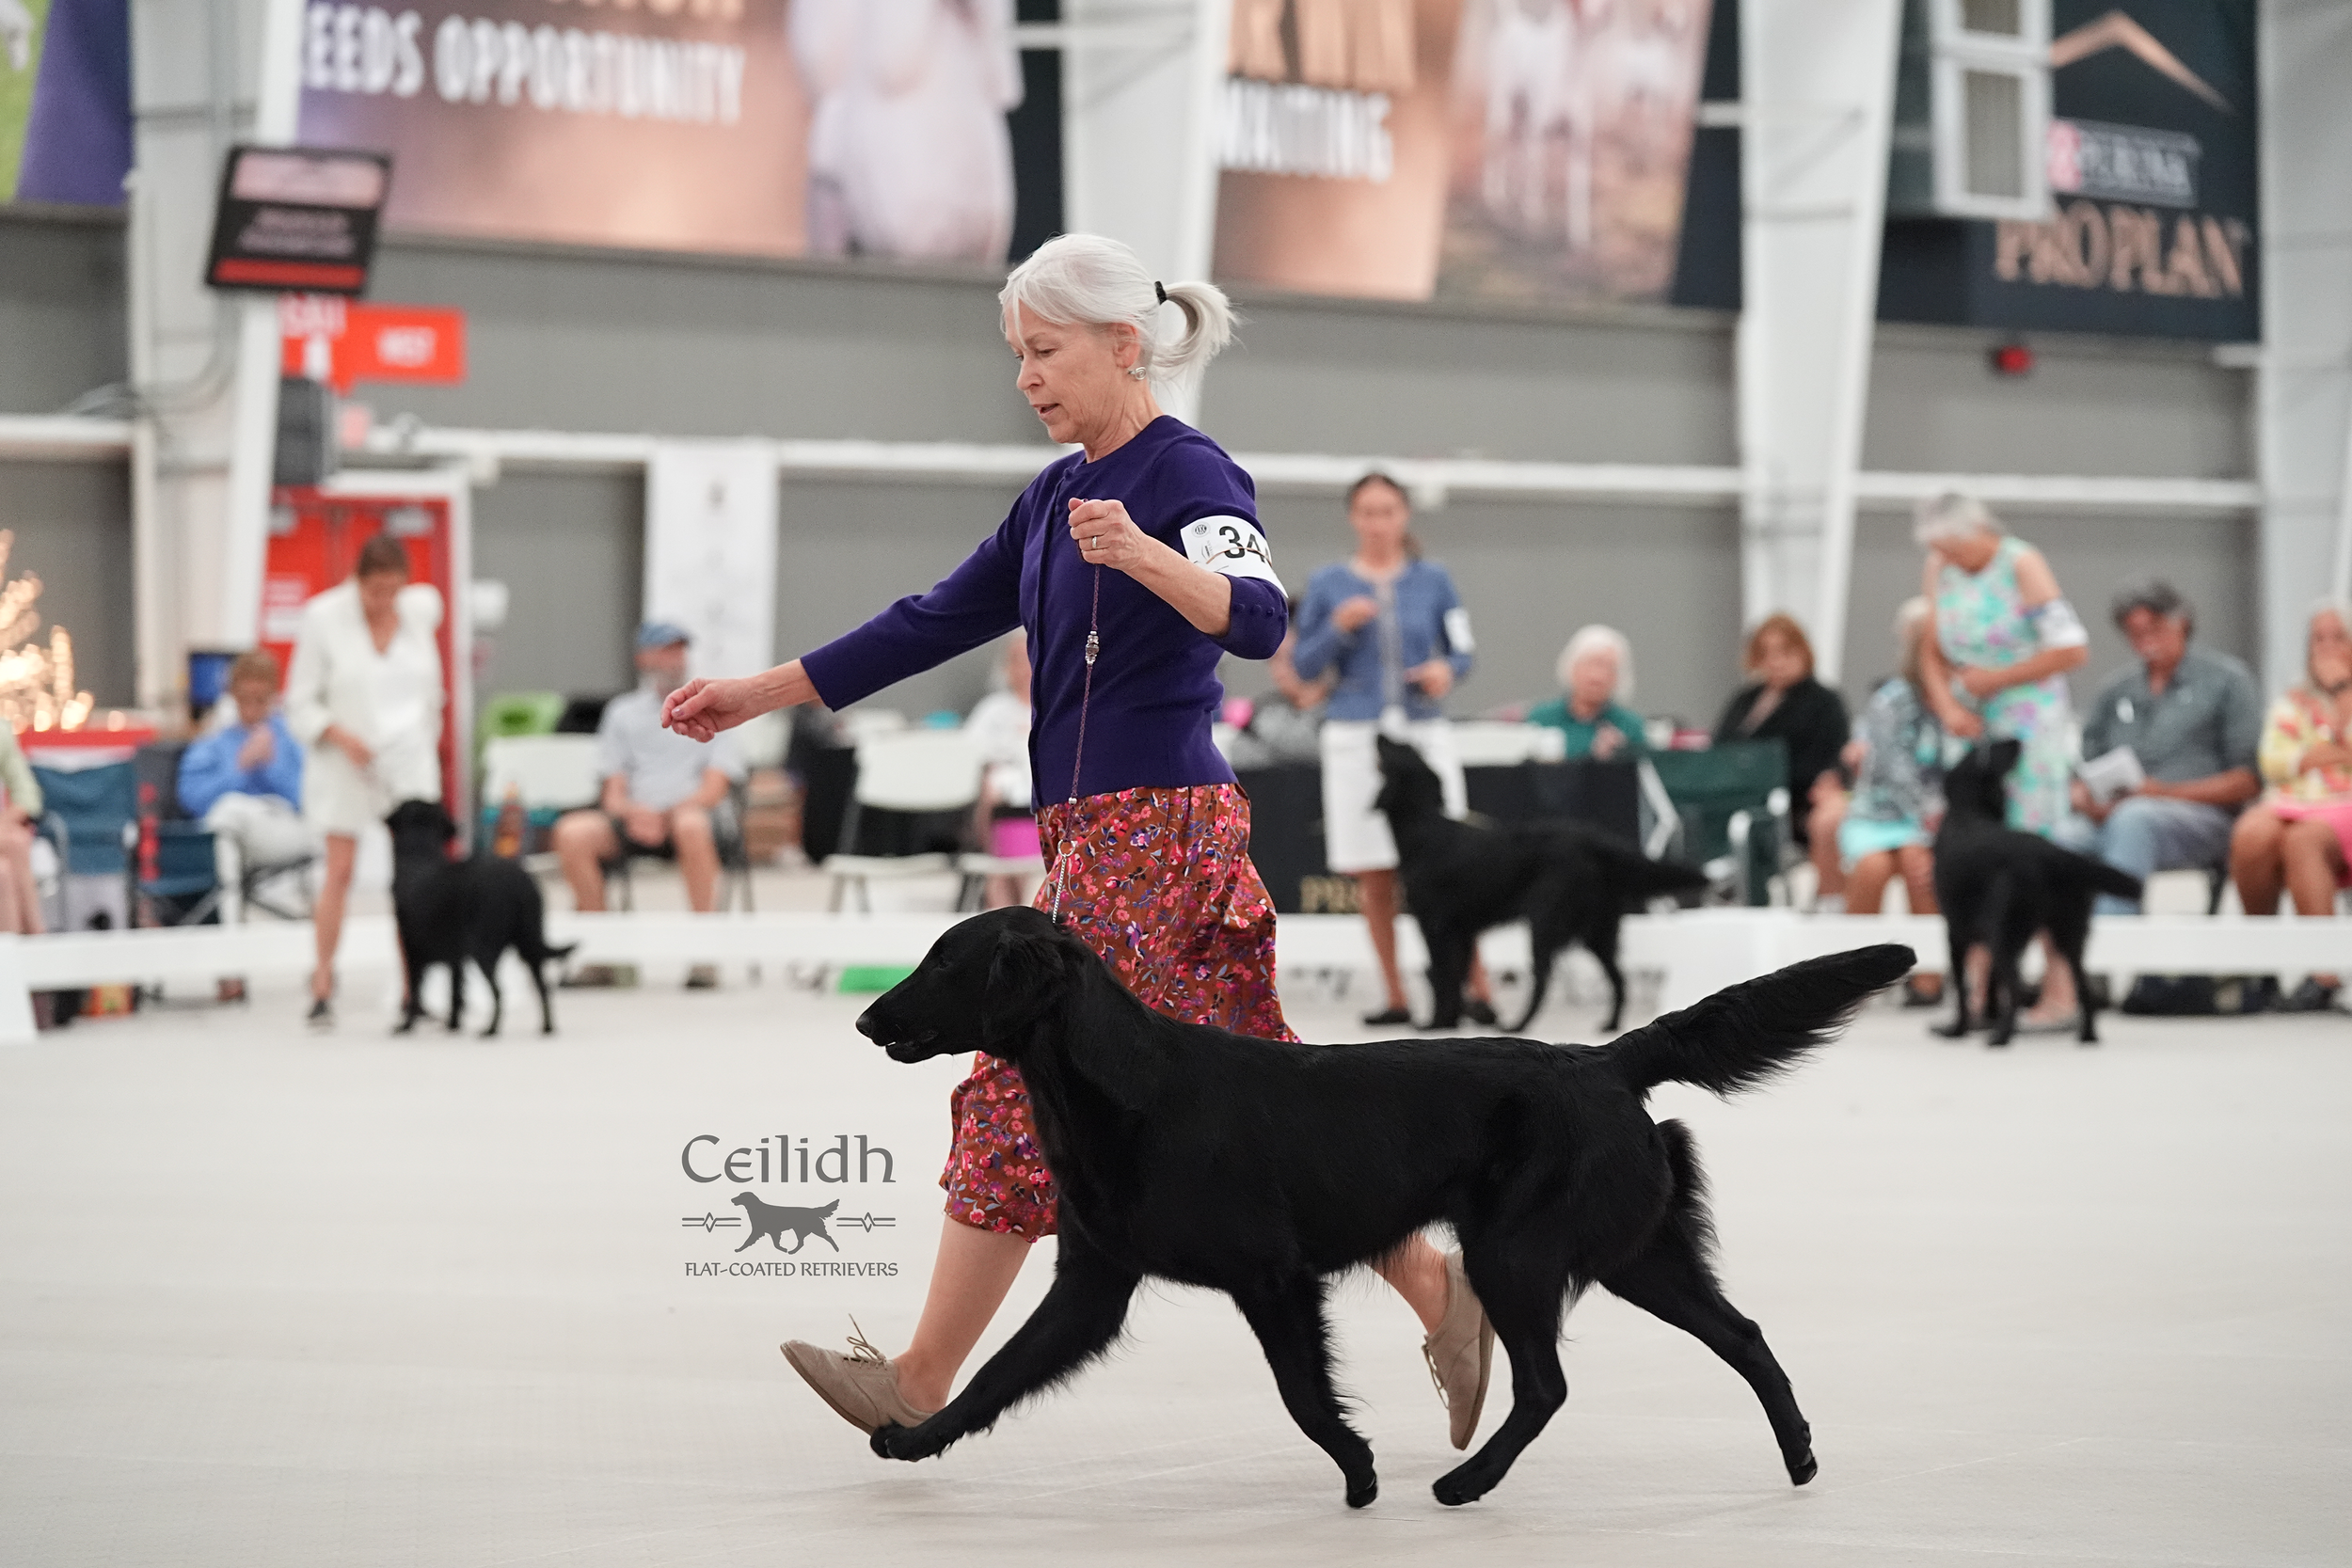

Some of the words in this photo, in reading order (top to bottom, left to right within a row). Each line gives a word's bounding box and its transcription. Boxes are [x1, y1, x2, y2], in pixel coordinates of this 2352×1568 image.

[300, 3, 424, 96] EEDS
[435, 13, 746, 126] OPPORTUNITY
[2110, 203, 2245, 299] PLAN
